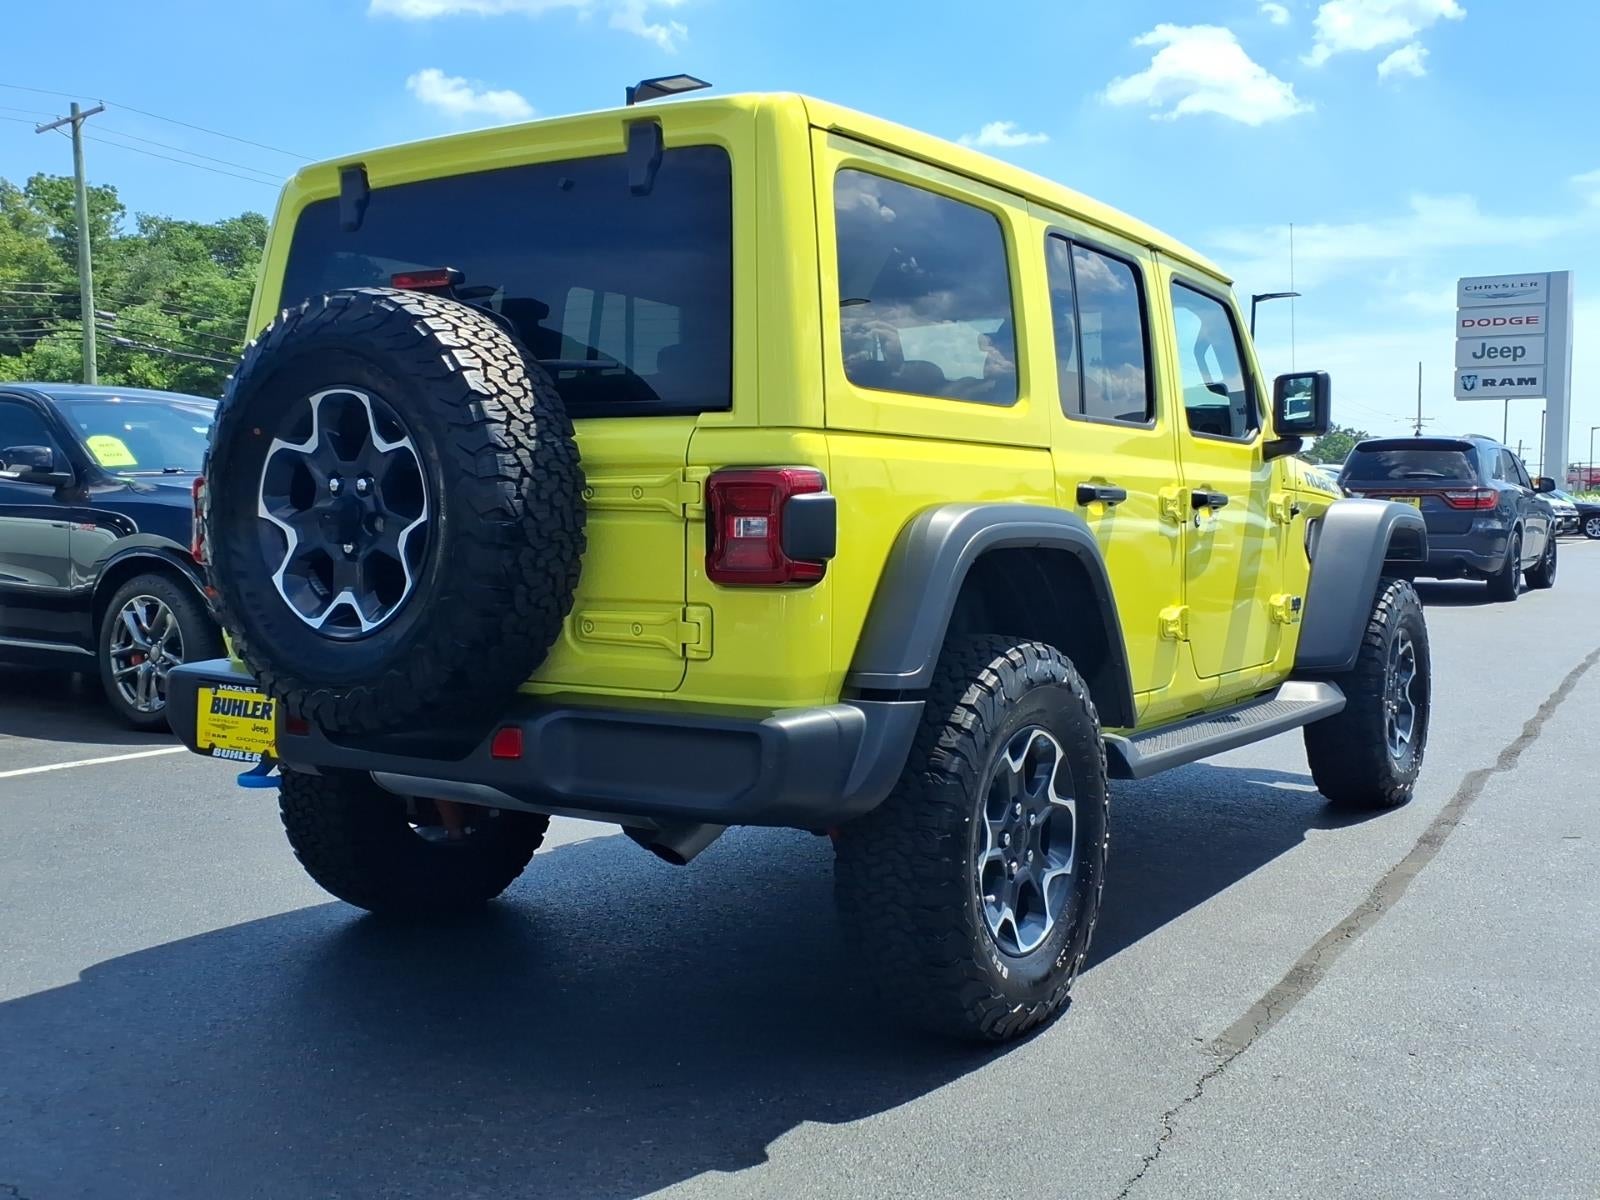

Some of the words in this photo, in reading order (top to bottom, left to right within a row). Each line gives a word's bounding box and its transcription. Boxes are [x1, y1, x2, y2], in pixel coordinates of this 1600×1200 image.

[1464, 282, 1538, 291] CHRYSLER
[1461, 315, 1540, 328] DODGE
[1471, 342, 1527, 362] Jeep
[1481, 377, 1537, 387] RAM
[219, 684, 258, 693] HAZLET
[210, 696, 273, 720] BUHLER
[251, 723, 269, 734] Jeep
[212, 747, 262, 762] BUHLER
